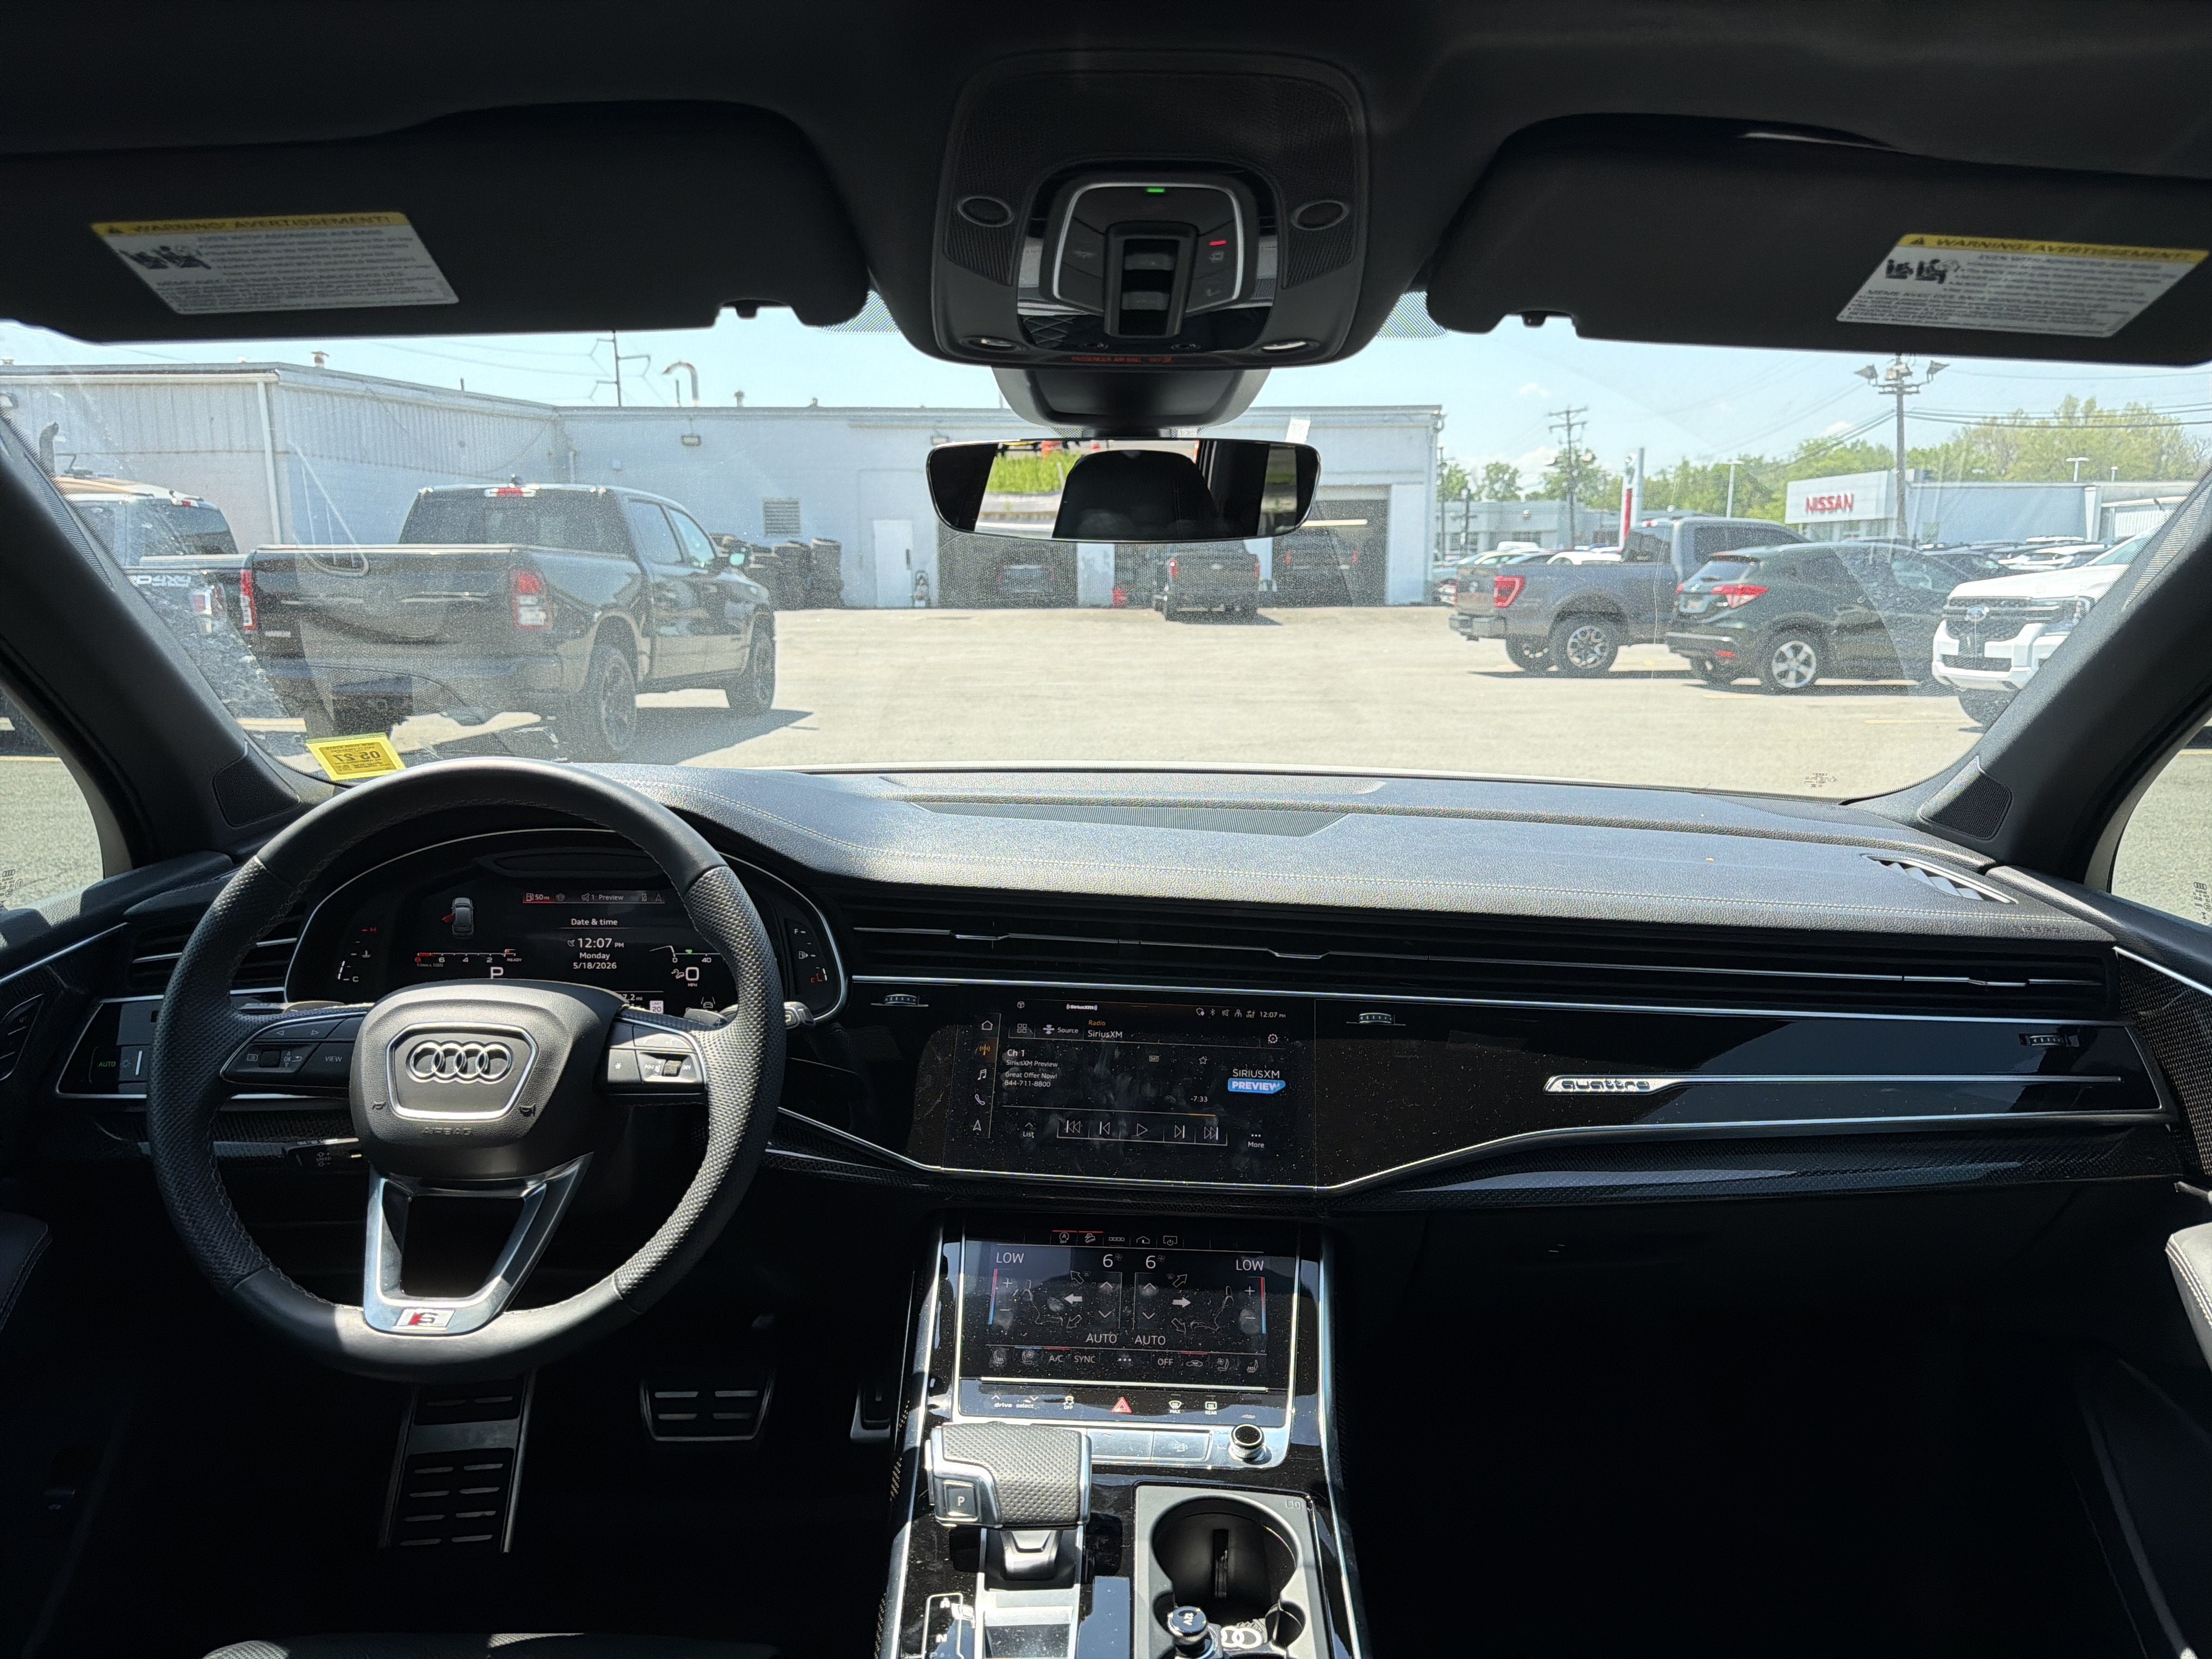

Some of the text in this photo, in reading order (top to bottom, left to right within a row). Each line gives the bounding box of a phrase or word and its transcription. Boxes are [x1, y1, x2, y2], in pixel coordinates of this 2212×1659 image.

[134, 216, 391, 232] WARNING! AVERTISSEMENT!
[1937, 239, 2030, 250] WARNING!
[1805, 493, 1854, 513] NISSAN
[577, 938, 612, 948] 12:07
[579, 952, 610, 961] Monday
[572, 962, 618, 970] 5/18/2026
[489, 966, 504, 979] P
[685, 966, 700, 981] 0
[1087, 1030, 1123, 1039] SiriusXM
[1232, 1069, 1280, 1079] SIRIUSXM
[1004, 1080, 1051, 1088] 844-711-8800
[1232, 1081, 1280, 1091] PREVIEW
[1561, 1080, 1651, 1090] quattro
[1022, 1130, 1035, 1138] List
[995, 1252, 1024, 1264] LOW
[1103, 1254, 1113, 1268] 6
[1146, 1255, 1156, 1269] 6
[1236, 1260, 1264, 1271] LOW
[1086, 1333, 1118, 1344] AUTO
[1135, 1334, 1166, 1345] AUTO
[1048, 1355, 1064, 1363] A/C
[1074, 1355, 1096, 1364] SYNC
[1157, 1358, 1173, 1366] OFF
[957, 1496, 966, 1506] P
[935, 1634, 947, 1643] N
